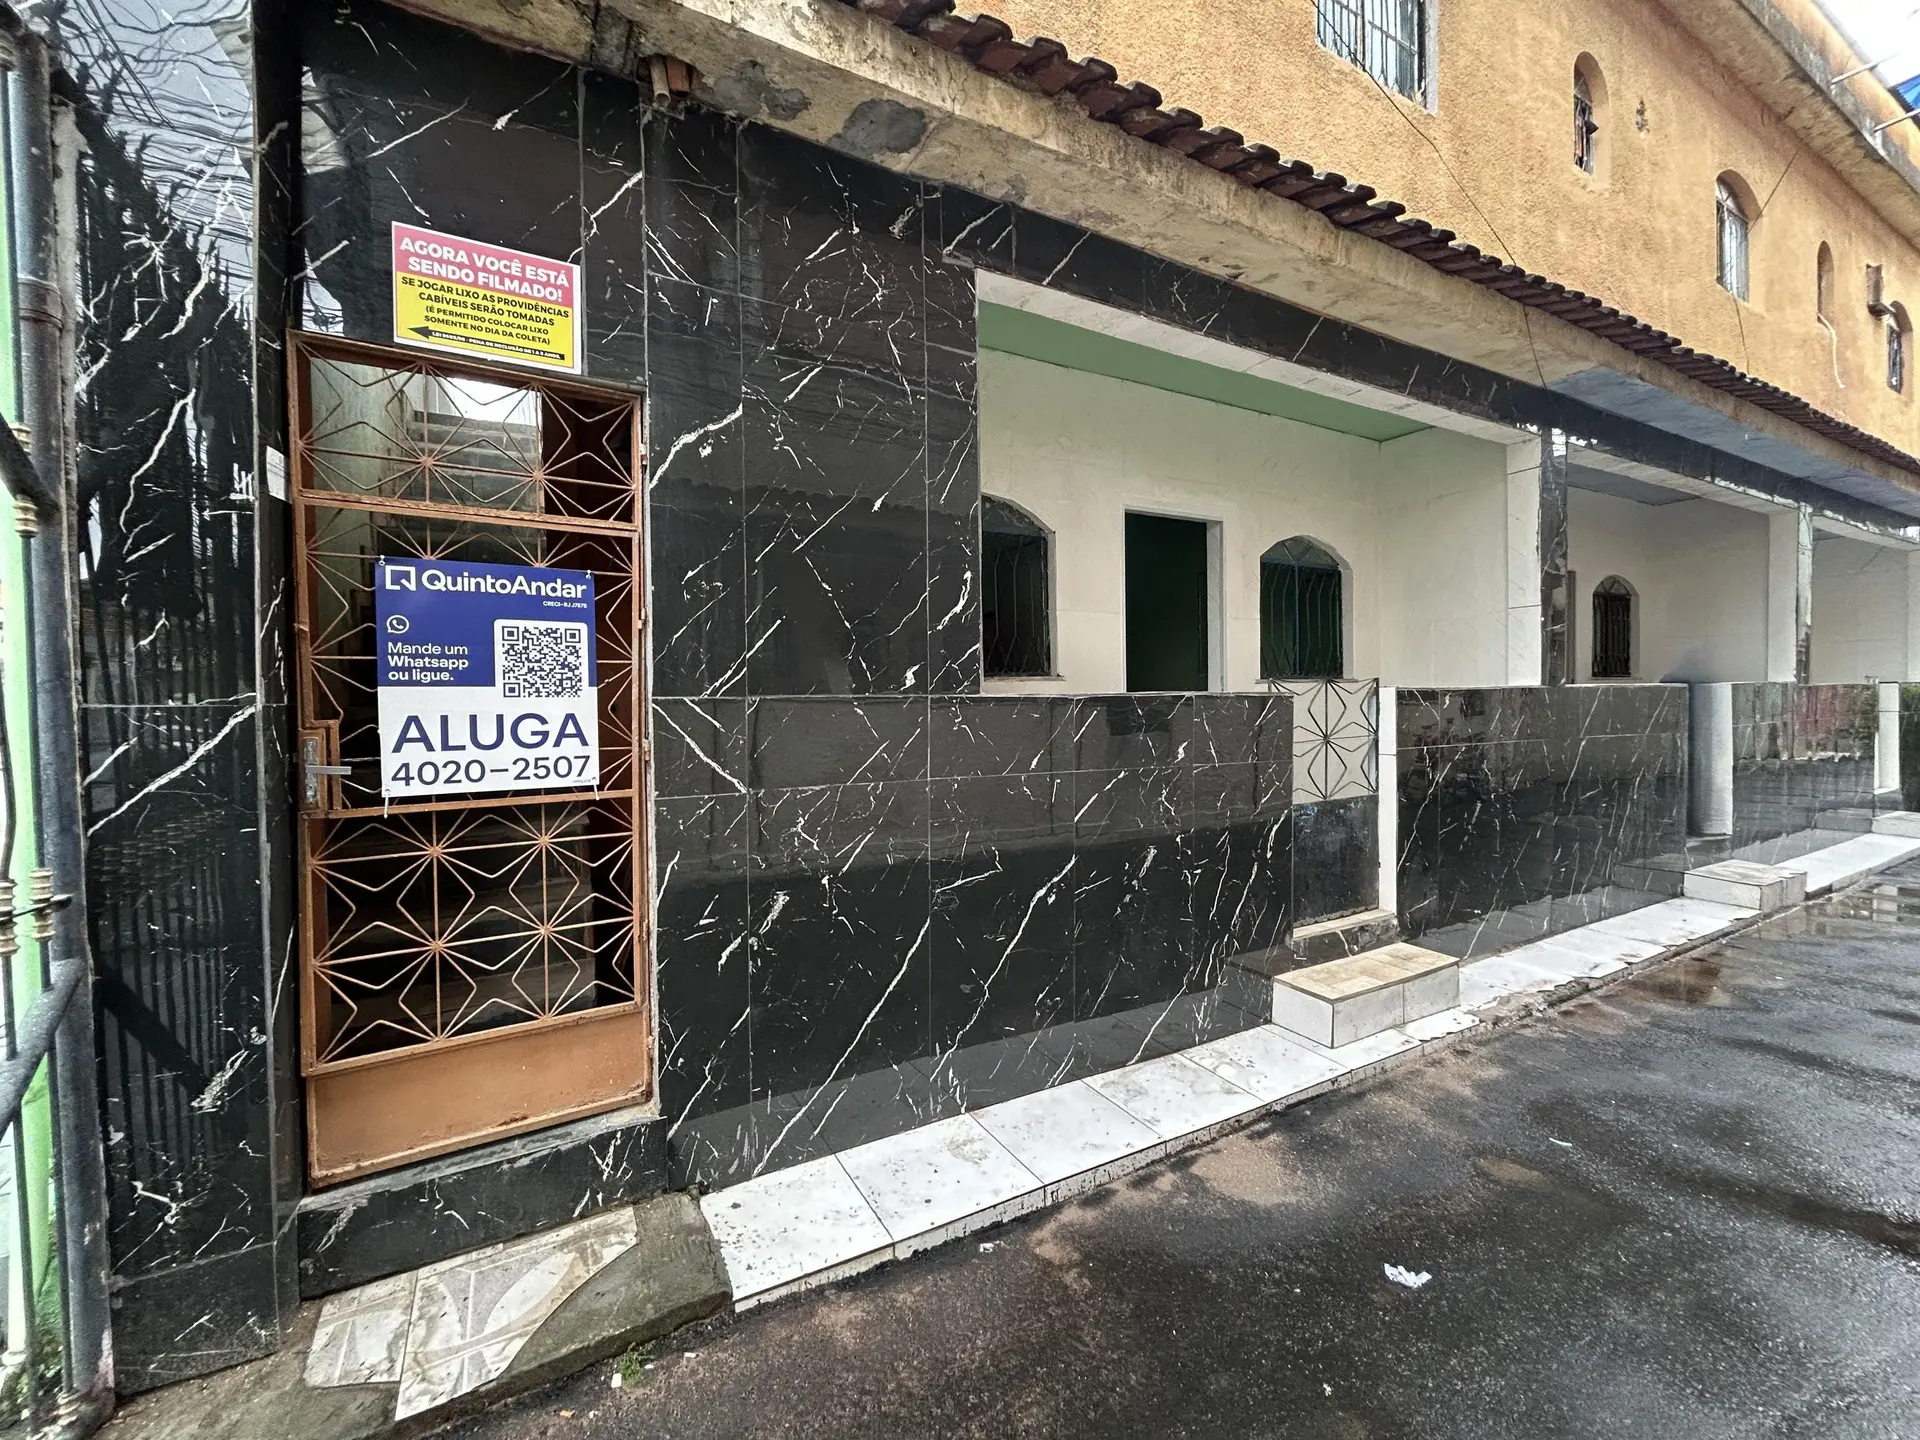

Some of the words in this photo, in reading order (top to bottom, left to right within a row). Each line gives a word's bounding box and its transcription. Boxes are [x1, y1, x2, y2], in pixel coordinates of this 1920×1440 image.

[400, 237, 469, 264] AGORA
[472, 253, 523, 276] VOCÊ
[526, 267, 569, 287] ESTÁ
[408, 257, 474, 283] SENDO
[478, 272, 562, 302] FILMADO!
[402, 276, 415, 286] SE
[417, 280, 453, 294] JOGAR
[456, 288, 479, 300] LIXO
[482, 293, 495, 303] AS
[498, 297, 569, 318] PROVIDÊNCIAS
[419, 292, 468, 309] CABÍVEIS
[470, 302, 504, 316] SERÃO
[507, 310, 555, 326] TOMADAS
[424, 315, 468, 329] SOMENTE
[470, 324, 483, 332] NO
[485, 327, 499, 336] DIA
[502, 330, 514, 338] DA
[516, 332, 550, 345] COLETA)
[426, 305, 435, 314] (É
[437, 308, 486, 323] PERMITIDO
[488, 318, 528, 331] COLOCAR
[530, 326, 549, 335] LIXO
[422, 569, 586, 598] QuintoAndar
[388, 642, 442, 655] Mande
[445, 644, 468, 654] um
[388, 655, 468, 670] Whatsapp
[388, 670, 408, 680] ou
[413, 668, 454, 683] ligue.
[392, 713, 589, 753] ALUGA
[392, 755, 590, 786] 4020-2507
